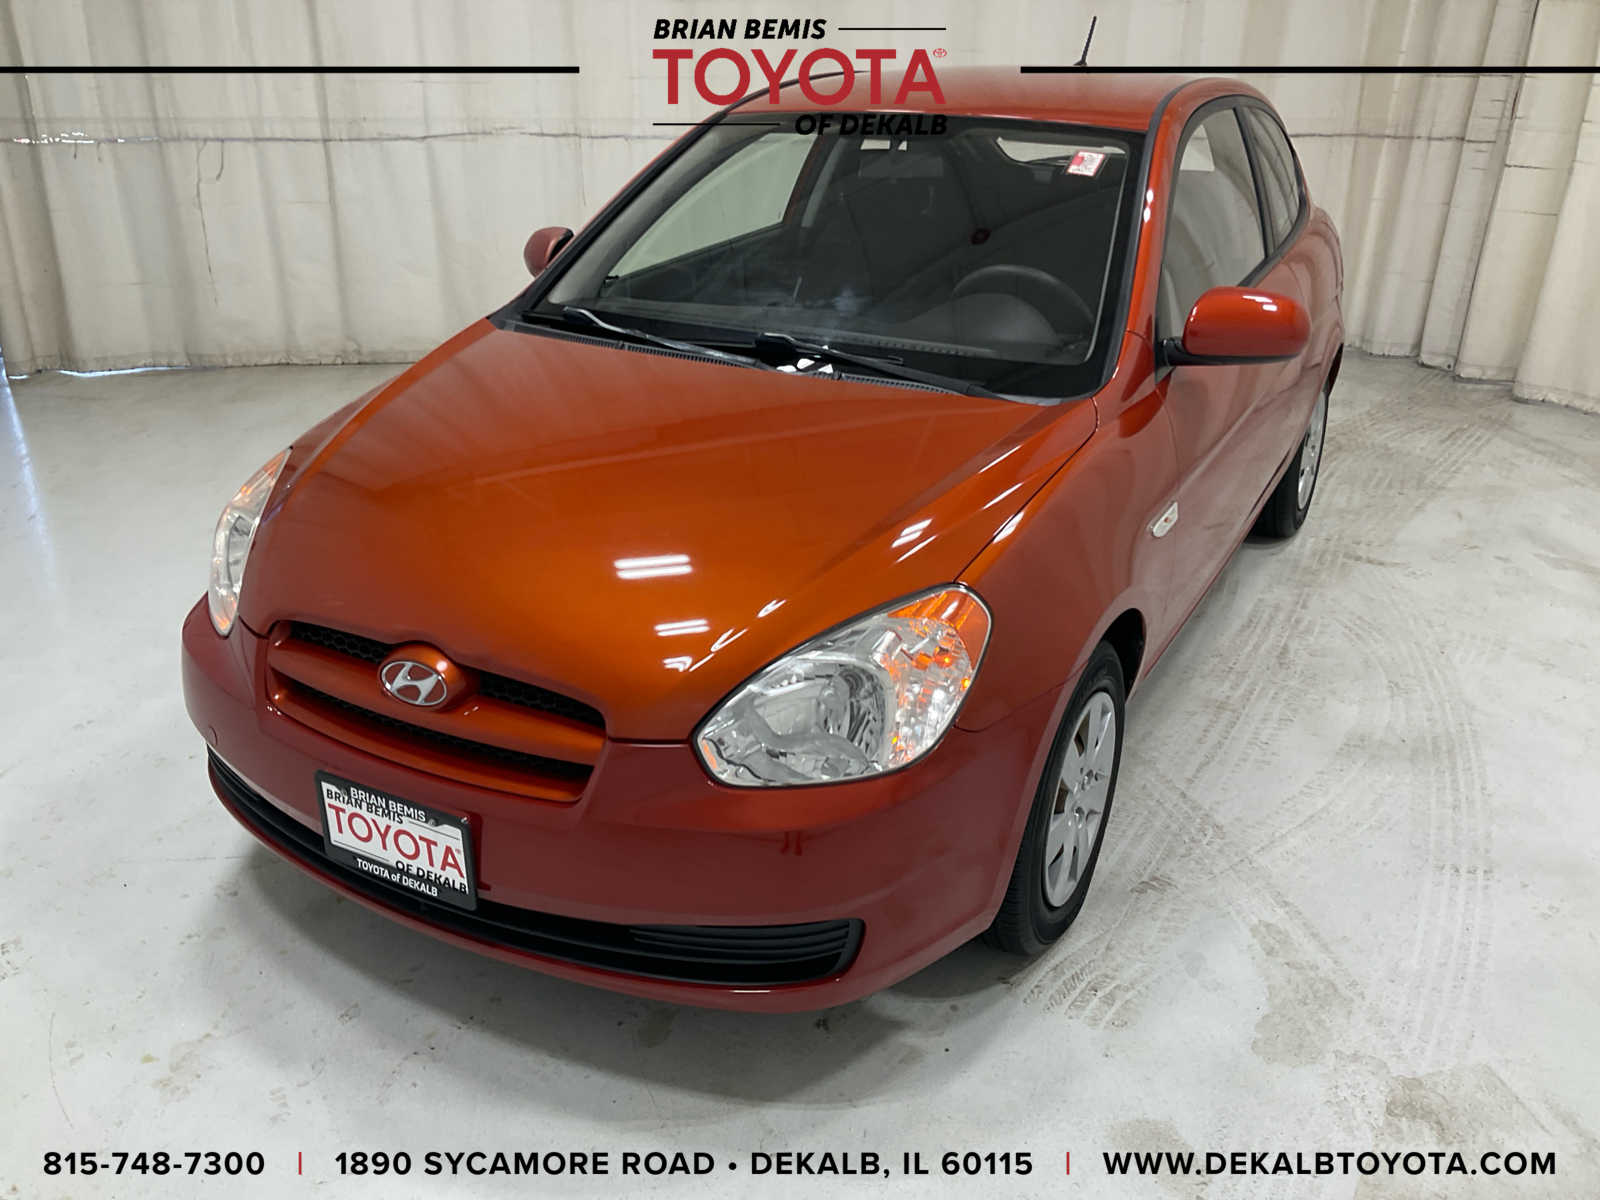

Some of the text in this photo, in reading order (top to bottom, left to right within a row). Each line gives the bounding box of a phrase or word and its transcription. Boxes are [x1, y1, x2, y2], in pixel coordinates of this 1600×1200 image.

[350, 787, 426, 822] BRIAN BEMIS
[328, 803, 465, 879] TOYOTA
[356, 857, 390, 879] TOYOTA
[402, 875, 438, 897] DEKALB
